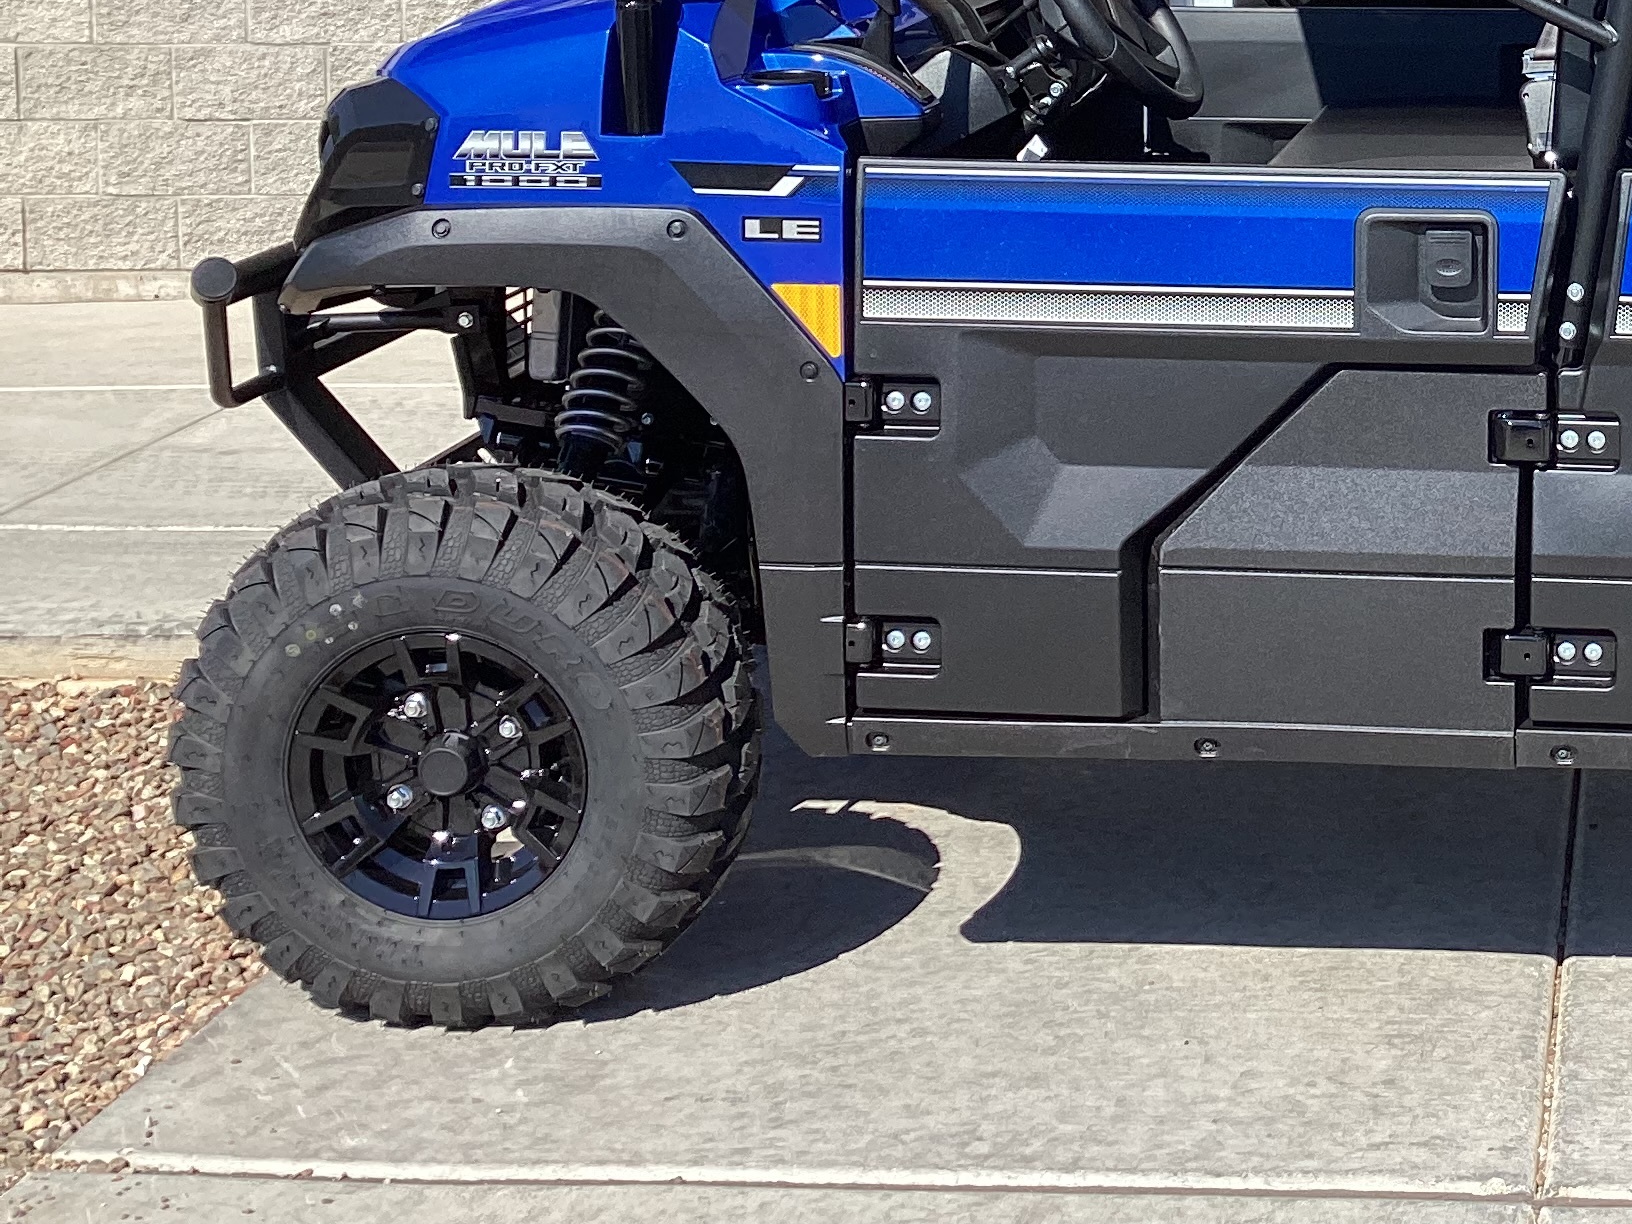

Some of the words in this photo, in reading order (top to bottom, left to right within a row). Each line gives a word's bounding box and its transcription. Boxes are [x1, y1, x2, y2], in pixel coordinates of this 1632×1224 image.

[452, 130, 600, 161] MULE
[463, 176, 588, 187] 1000
[743, 218, 821, 241] LE
